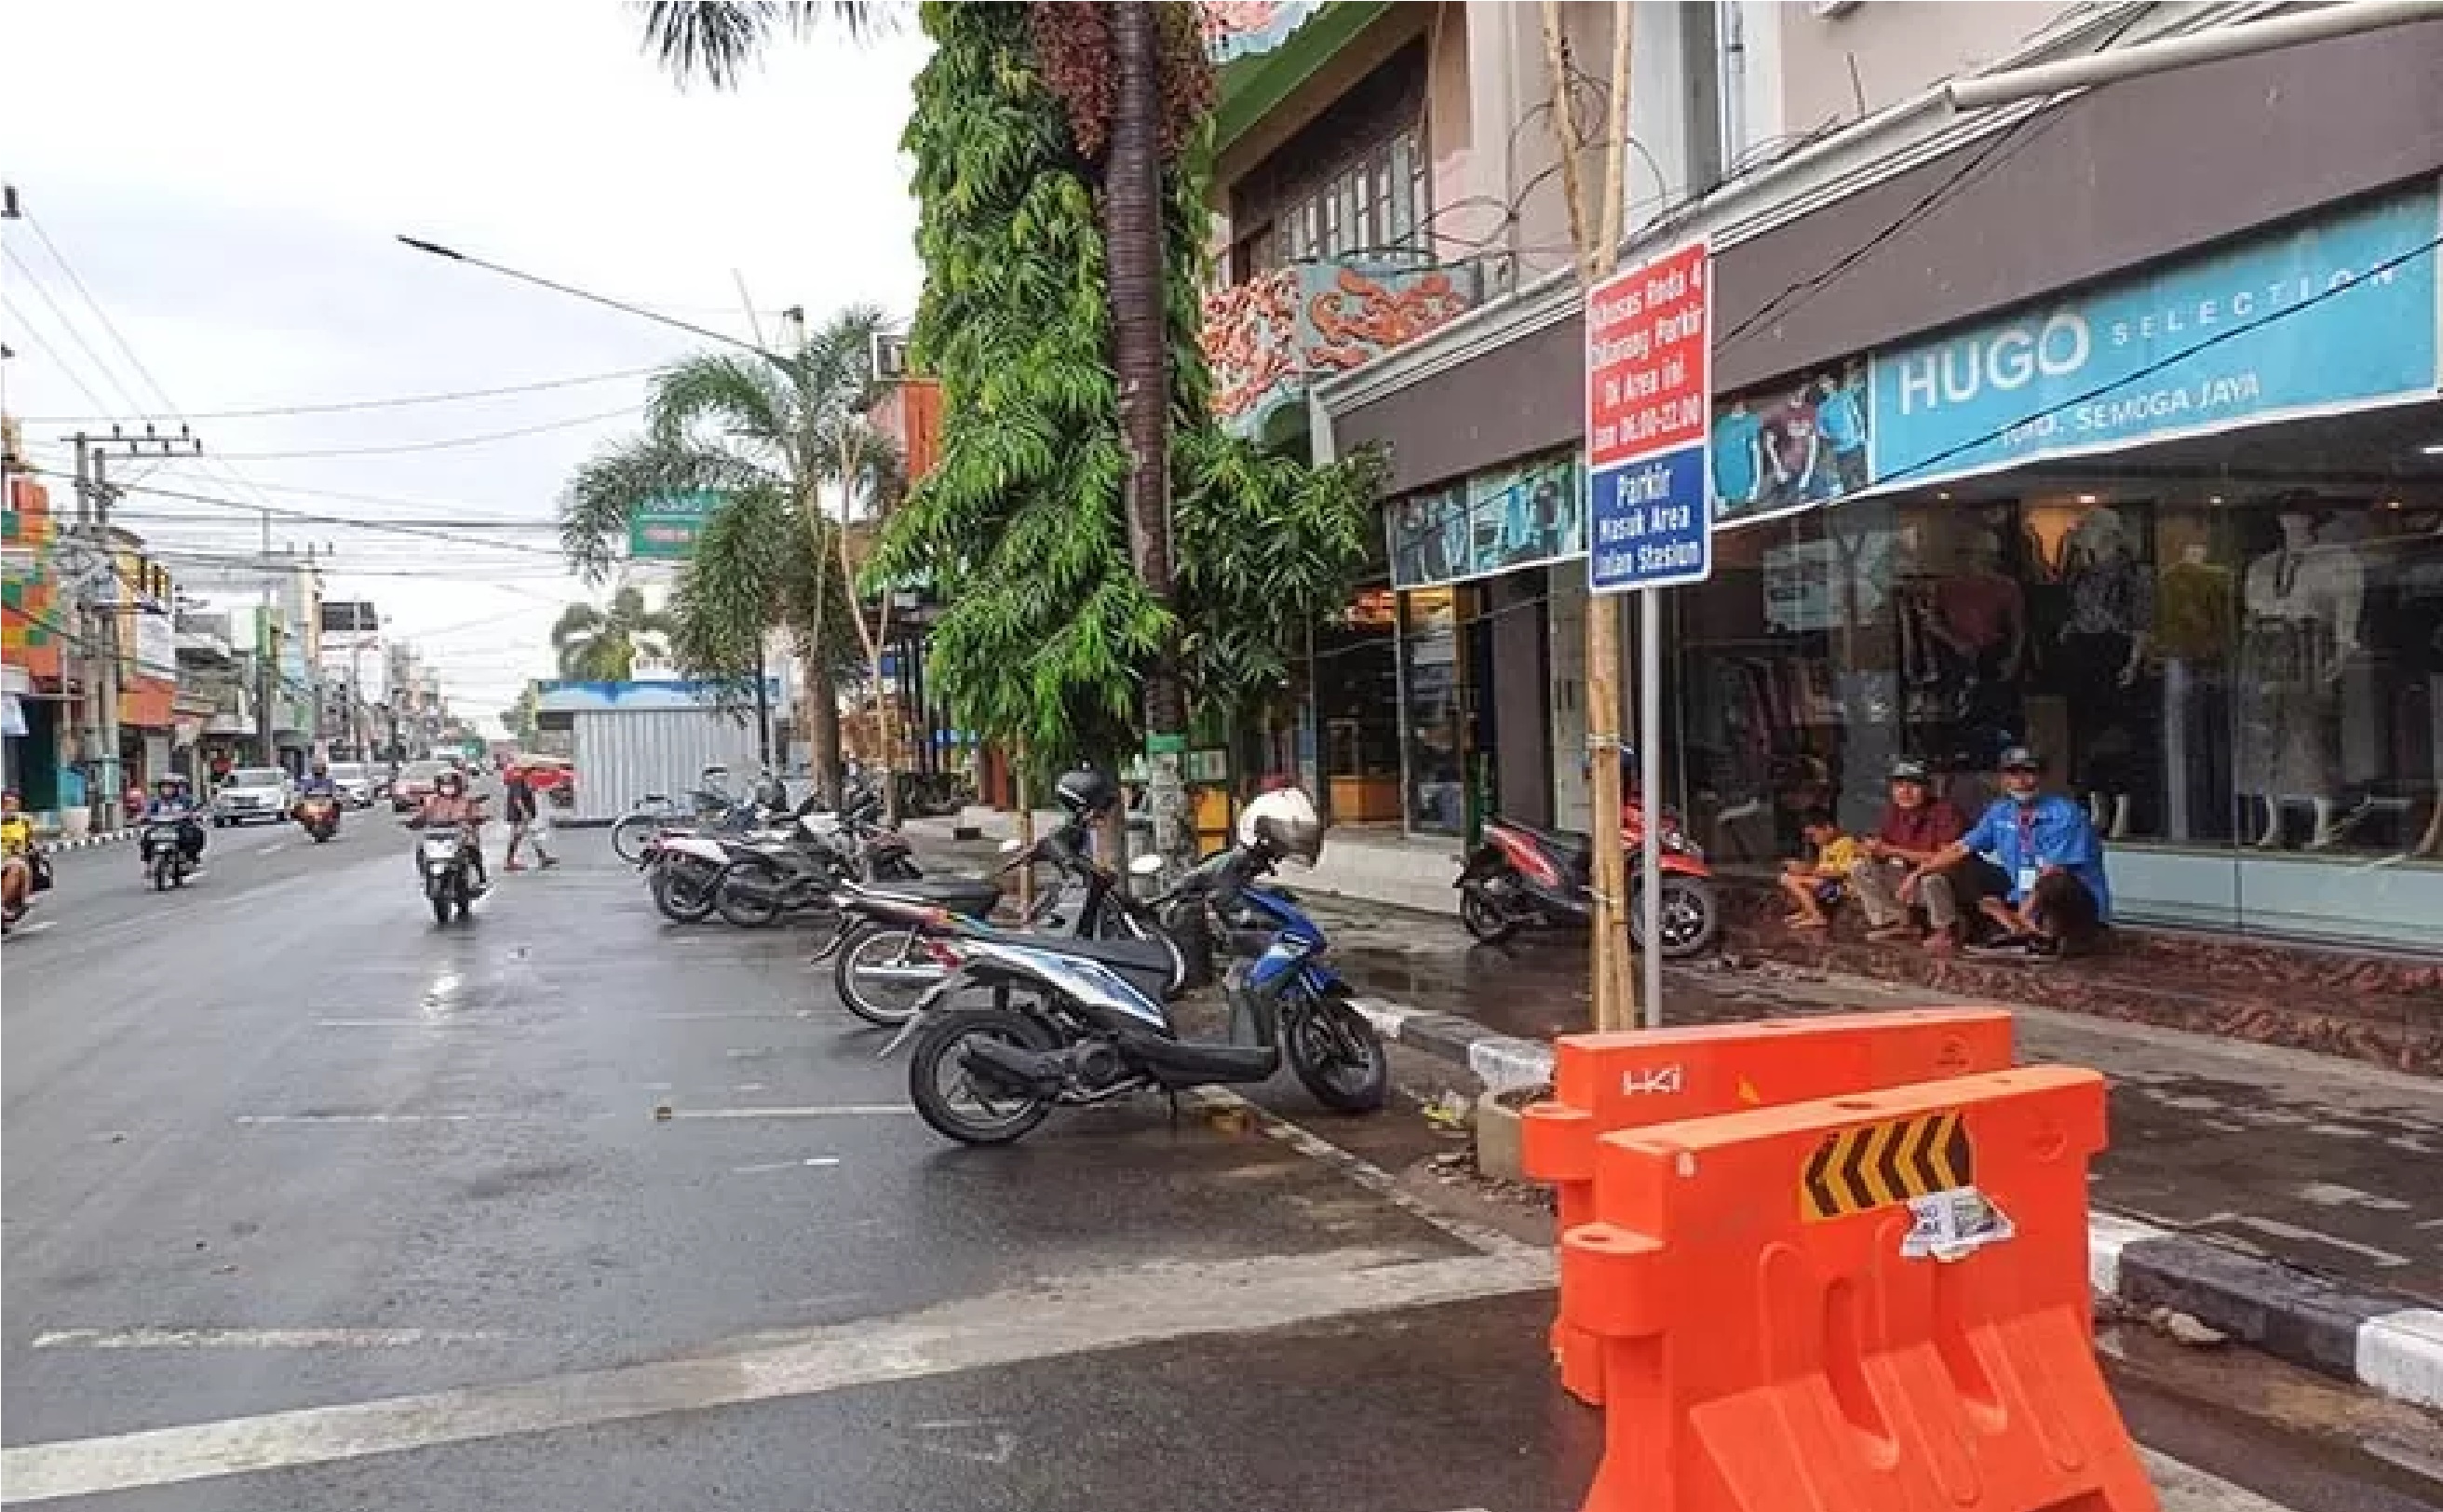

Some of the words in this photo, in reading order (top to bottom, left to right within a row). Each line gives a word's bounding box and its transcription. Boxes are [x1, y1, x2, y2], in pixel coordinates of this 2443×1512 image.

[1654, 302, 1702, 345] Parkir
[1898, 309, 2091, 415] HUGO
[2111, 262, 2398, 345] SELECTION
[1623, 370, 1660, 403] Area
[2076, 387, 2190, 435] SEMOGA
[2197, 371, 2261, 410] JAYA
[1617, 463, 1673, 508] Parkir
[1648, 506, 1691, 534] Area
